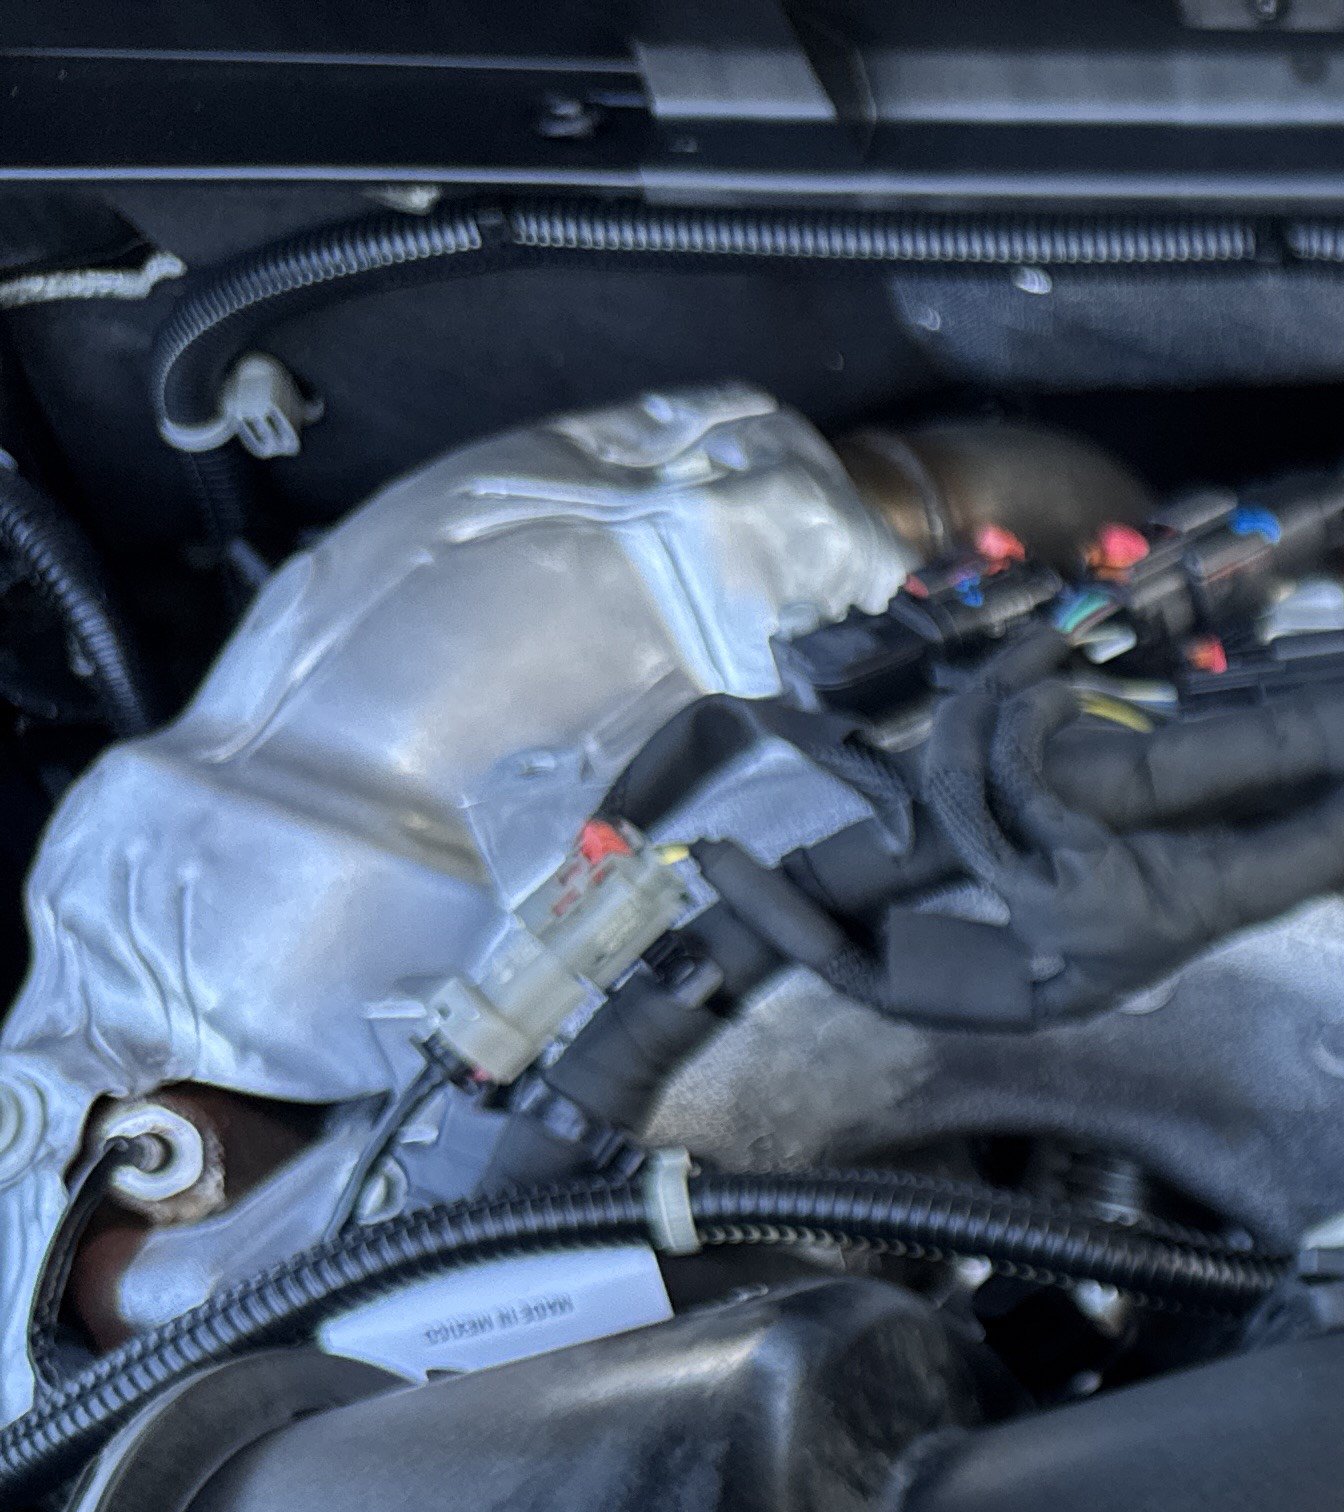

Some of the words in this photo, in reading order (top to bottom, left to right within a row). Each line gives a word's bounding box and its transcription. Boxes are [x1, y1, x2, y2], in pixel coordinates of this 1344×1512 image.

[498, 1305, 518, 1328] IN
[519, 1295, 574, 1324] MADE
[424, 1313, 494, 1345] MEXICO
